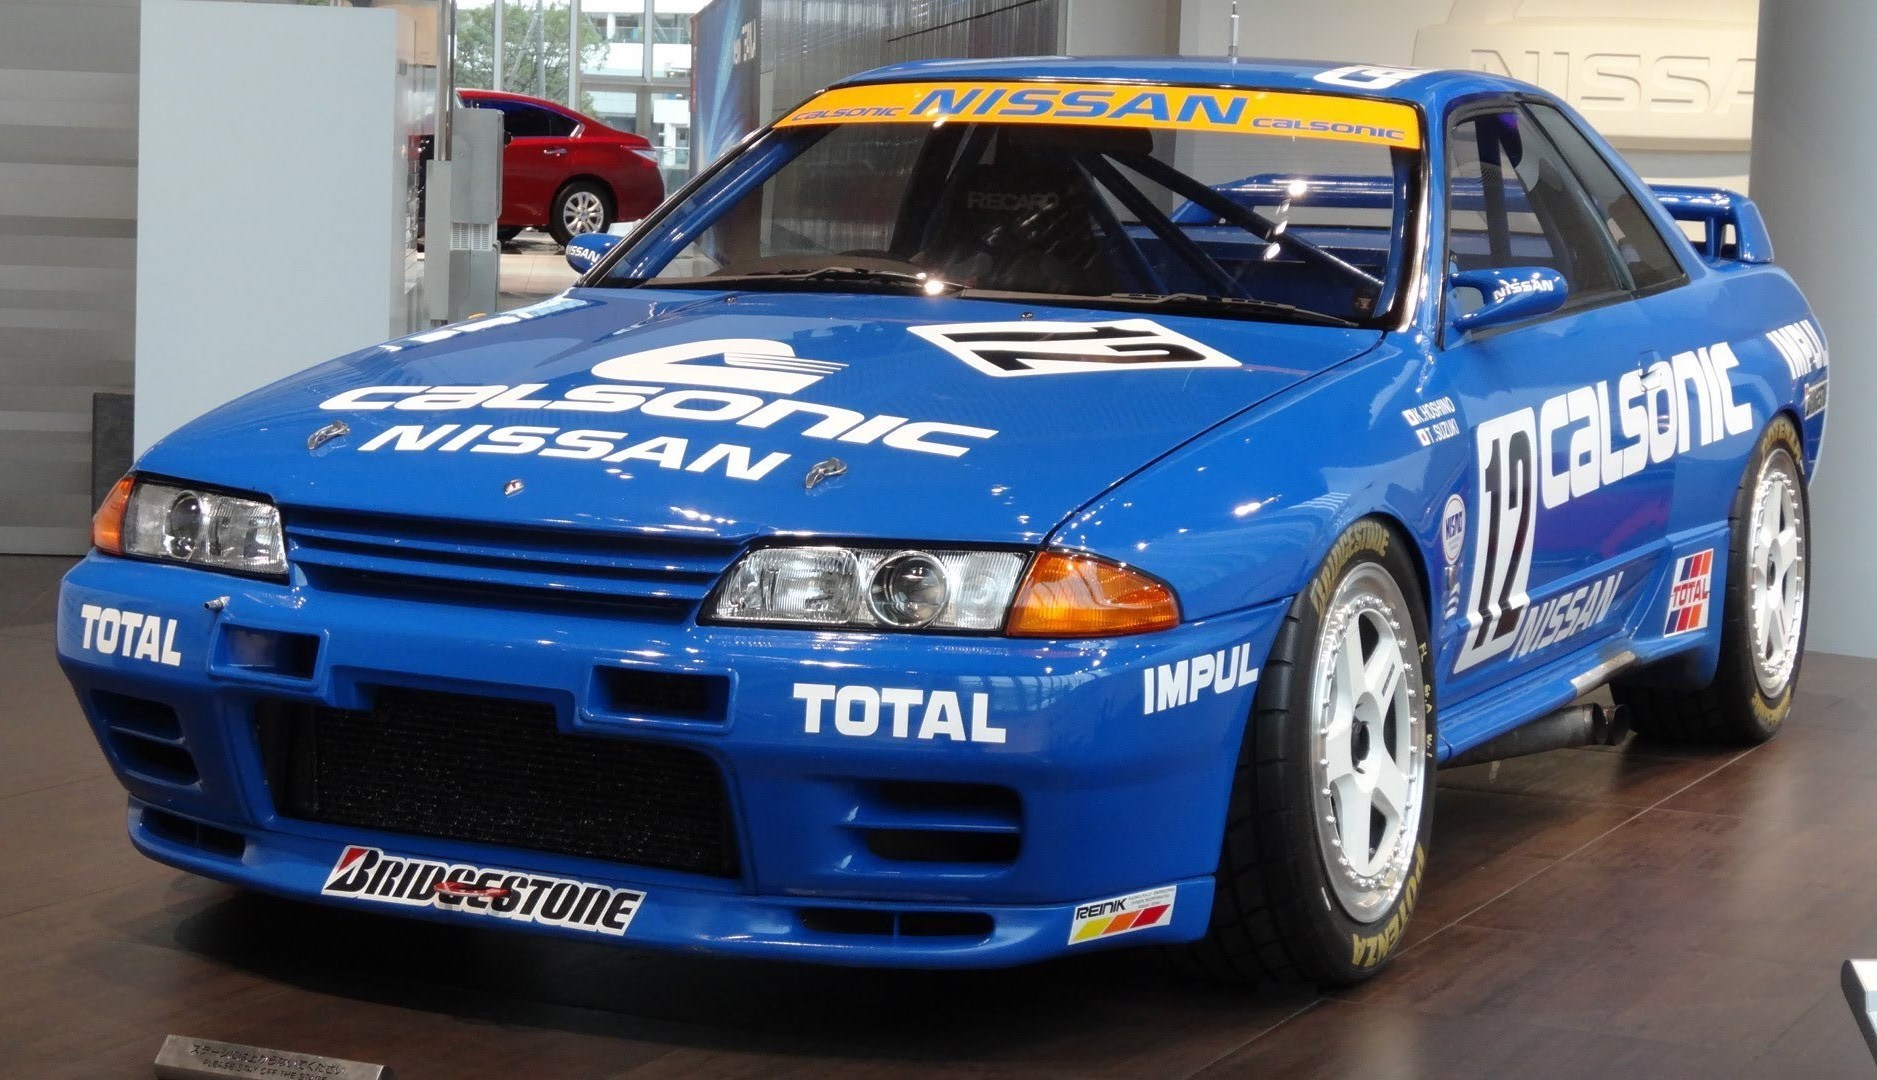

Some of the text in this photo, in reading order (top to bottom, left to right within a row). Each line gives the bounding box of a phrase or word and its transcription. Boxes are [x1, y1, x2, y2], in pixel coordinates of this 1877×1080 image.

[908, 88, 1248, 125] NISSAN
[566, 245, 600, 263] NISSAN
[1493, 279, 1554, 301] NISSAN
[357, 424, 792, 481] NISSAN
[1472, 429, 1535, 651] 12
[1508, 571, 1625, 662] NISSAN
[1672, 577, 1709, 608] TOTAL
[81, 604, 181, 666] TOTAL
[1142, 642, 1259, 715] IMPUL
[793, 683, 1006, 743] TOTAL
[324, 848, 641, 930] BRIDGESTONE
